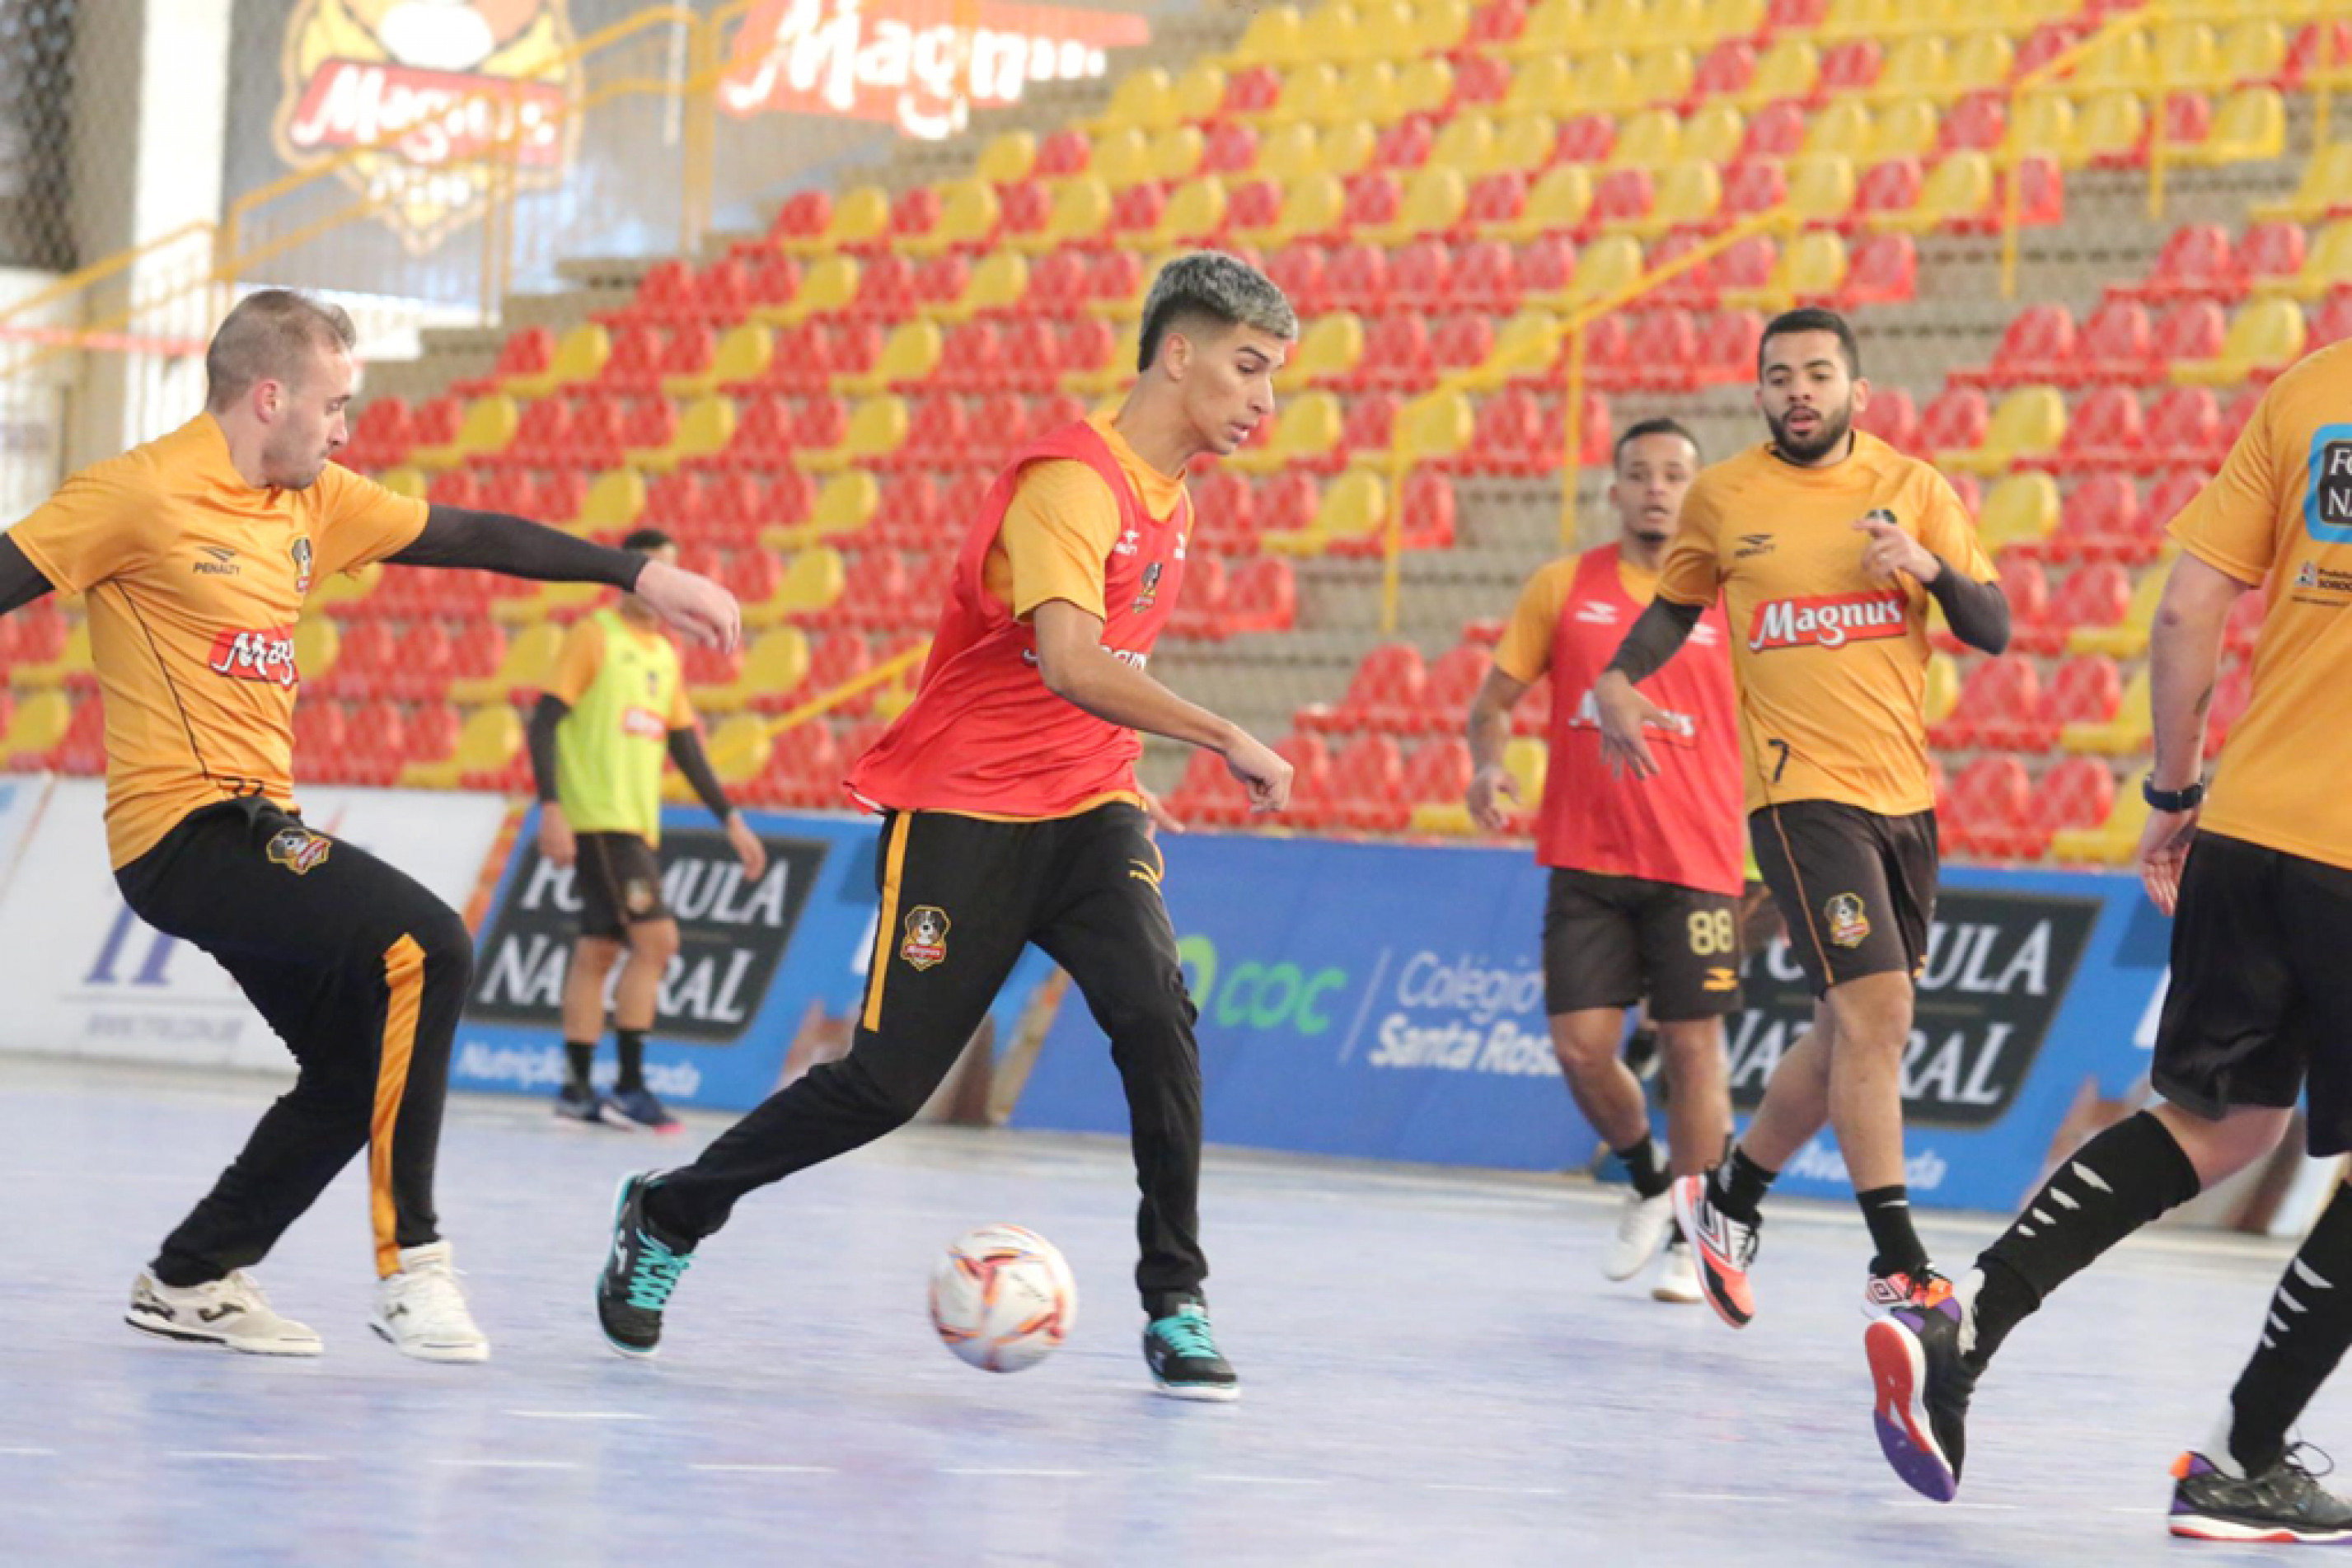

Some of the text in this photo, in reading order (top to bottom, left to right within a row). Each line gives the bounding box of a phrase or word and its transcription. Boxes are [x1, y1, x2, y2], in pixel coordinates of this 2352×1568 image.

[1749, 598, 1902, 648] Magnus
[1768, 739, 1789, 783] 7
[1688, 908, 1734, 956] 88
[1216, 962, 1347, 1036] coc
[1398, 951, 1545, 1024] Colégio
[1369, 1013, 1481, 1070] Santa
